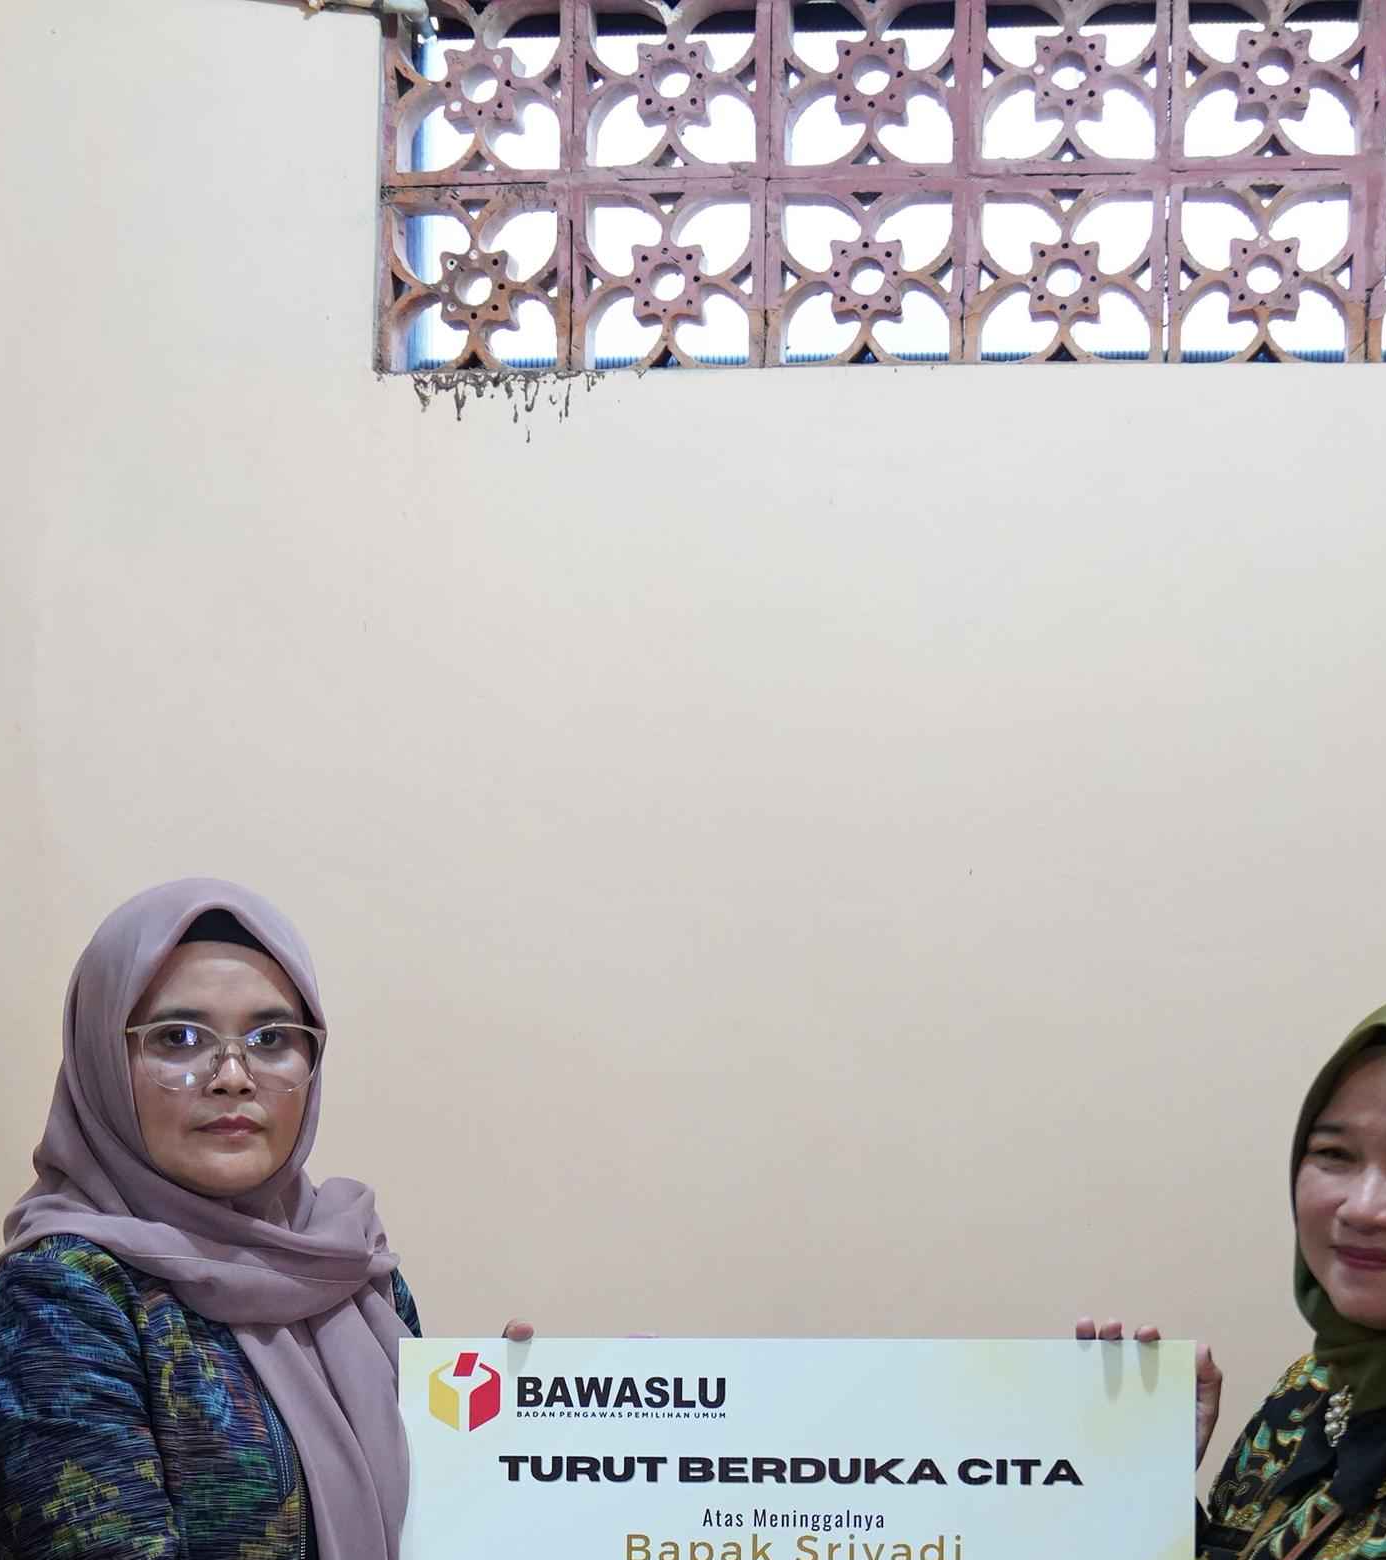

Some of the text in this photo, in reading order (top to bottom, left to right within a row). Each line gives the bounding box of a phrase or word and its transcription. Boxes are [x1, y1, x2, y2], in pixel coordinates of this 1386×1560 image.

[516, 1376, 726, 1409] BAWASLU
[516, 1410, 556, 1418] BADAN
[559, 1411, 623, 1419] PENGAWAS
[627, 1411, 690, 1419] PEMILIHAN
[498, 1455, 1084, 1486] TURUT BERDUKA CITA
[702, 1508, 884, 1532] Atas Meninggalnya
